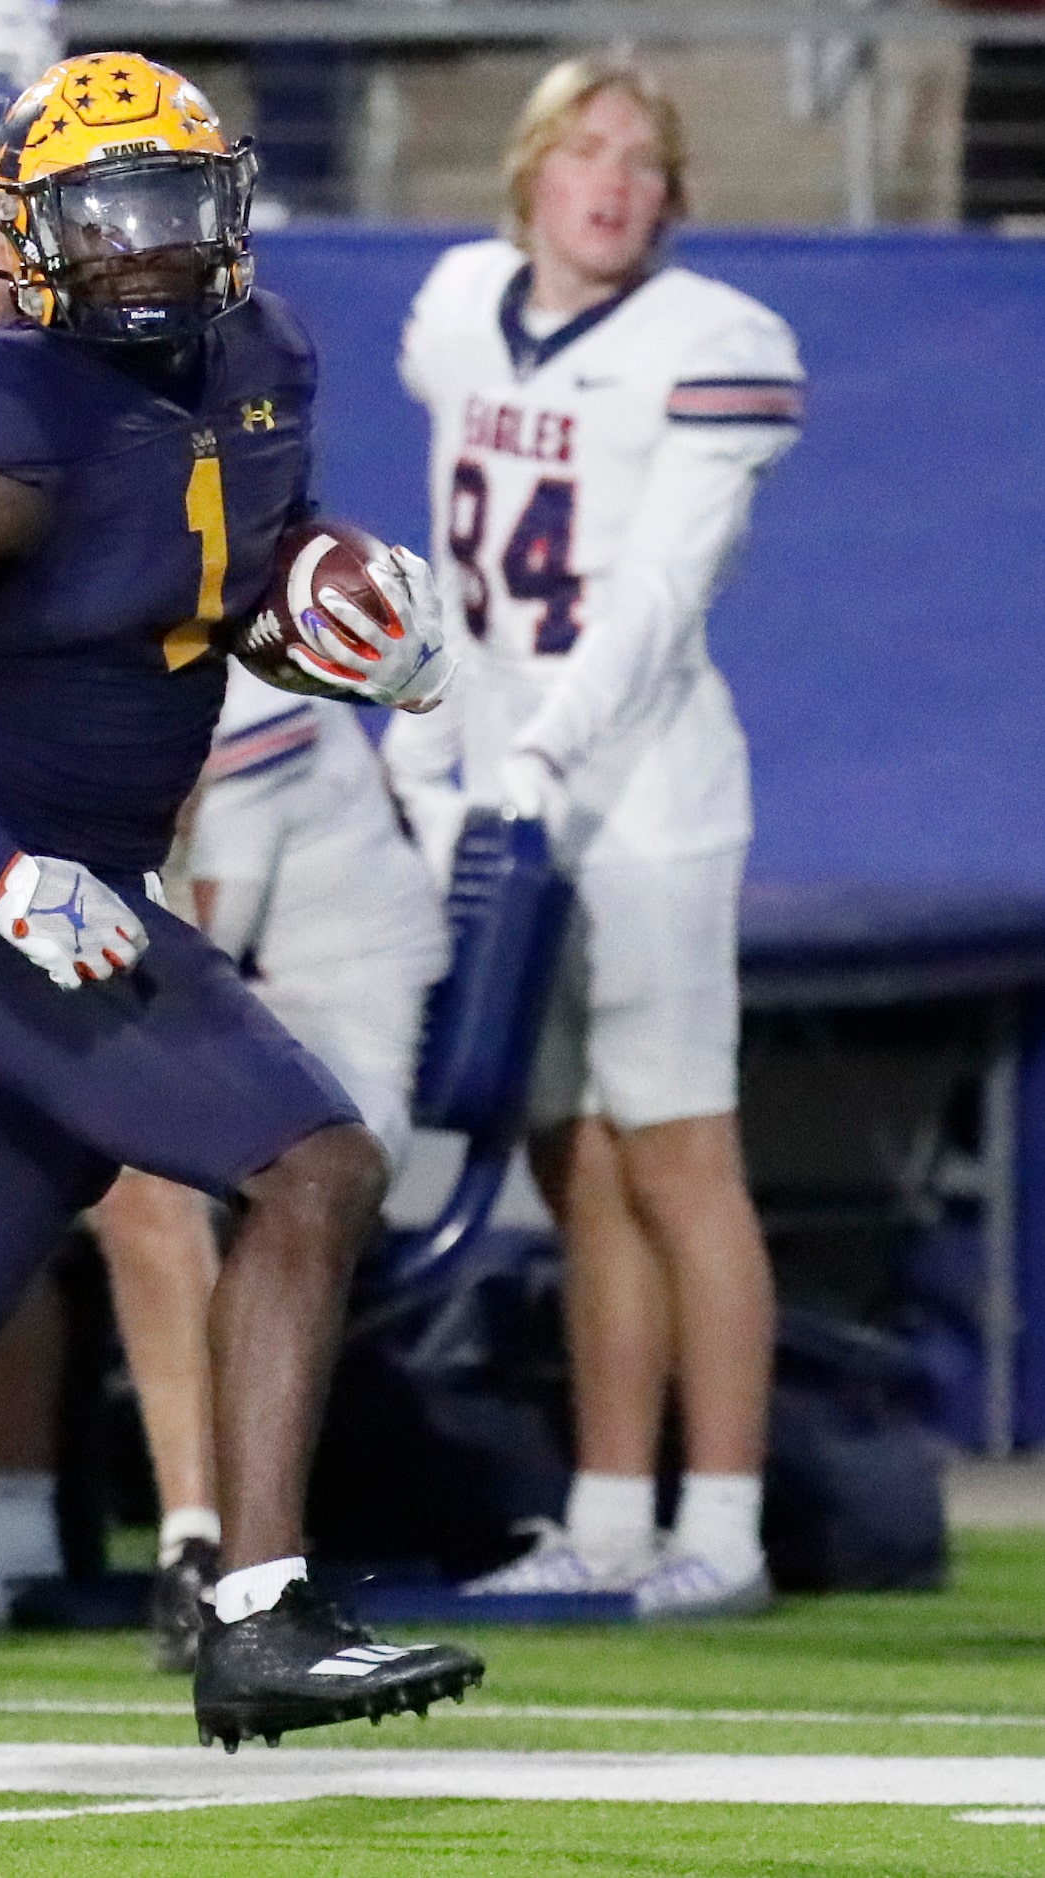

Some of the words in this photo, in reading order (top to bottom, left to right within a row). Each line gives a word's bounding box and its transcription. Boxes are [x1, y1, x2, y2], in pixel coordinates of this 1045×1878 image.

[464, 394, 575, 463] EAGLES
[162, 457, 229, 672] 1
[449, 457, 584, 656] 84
